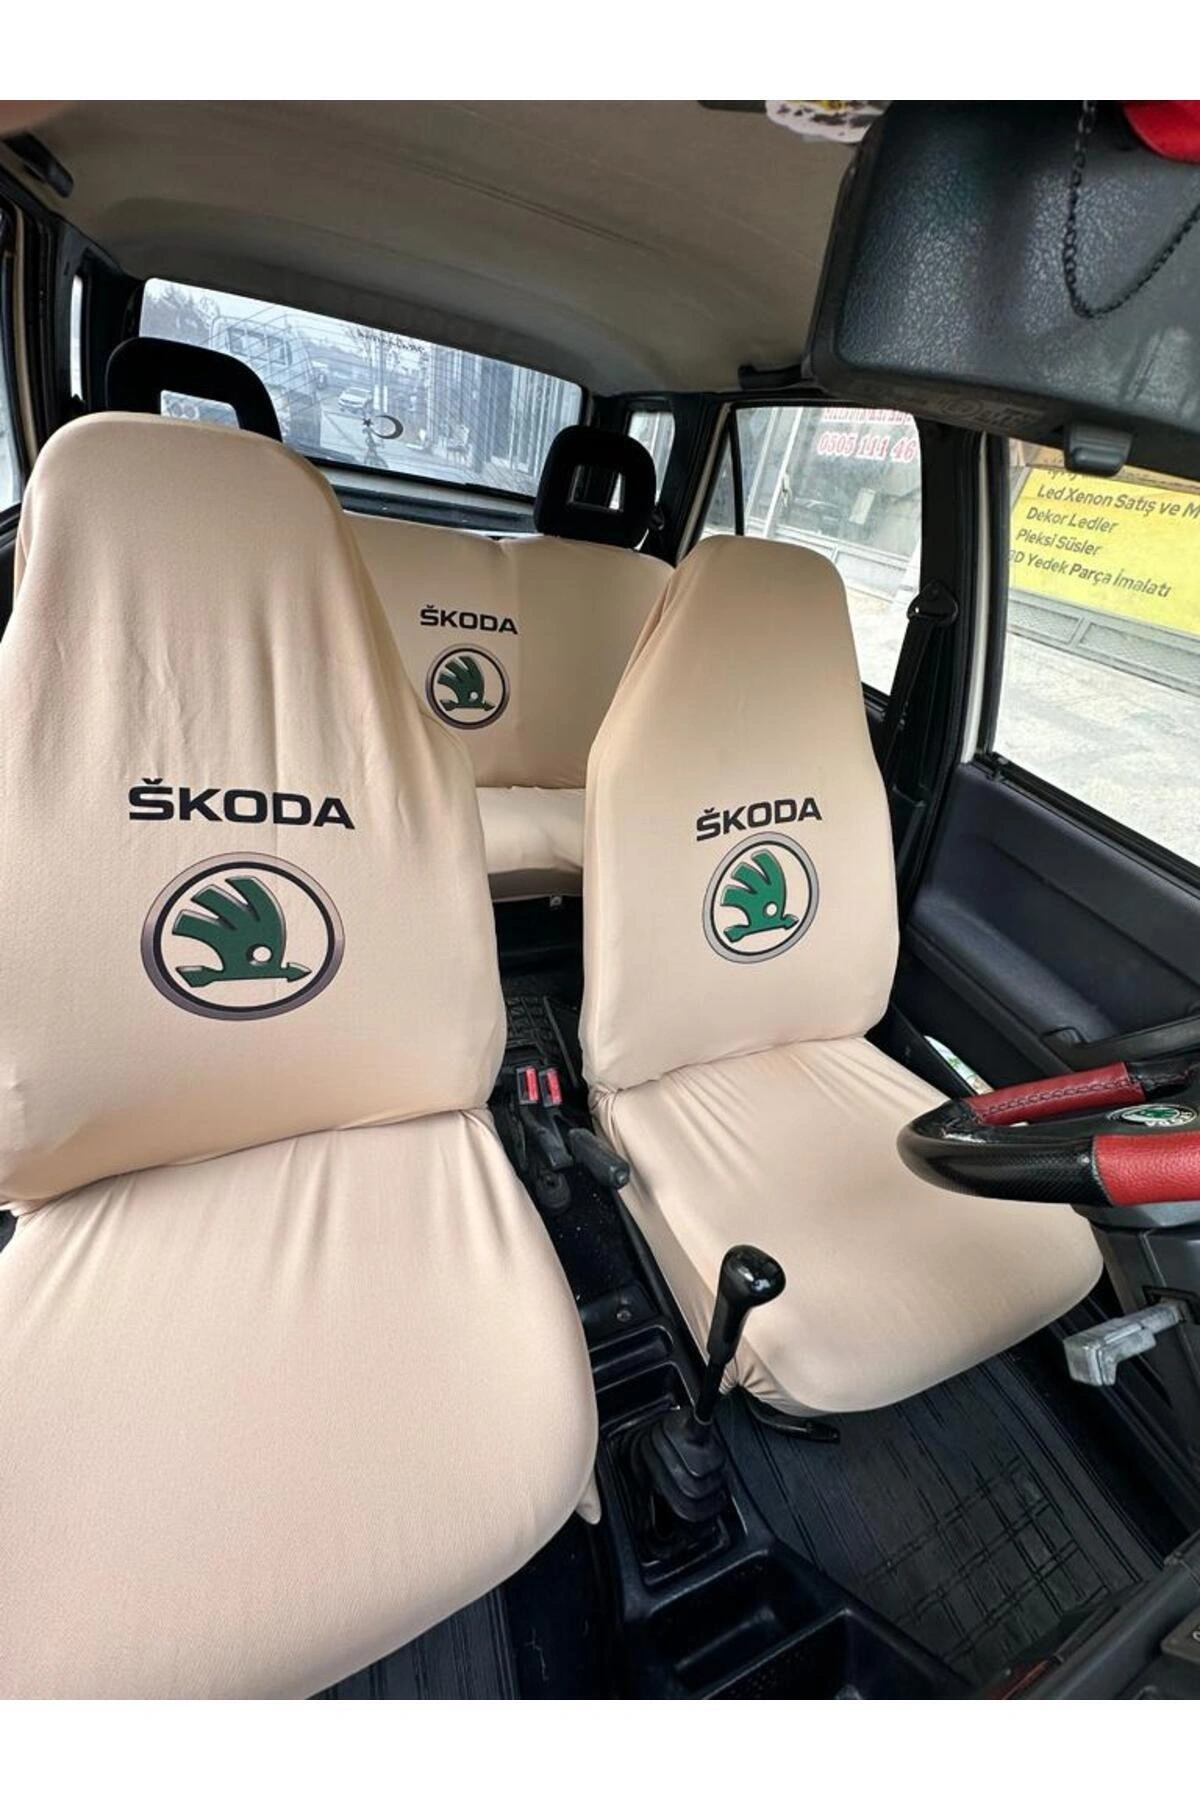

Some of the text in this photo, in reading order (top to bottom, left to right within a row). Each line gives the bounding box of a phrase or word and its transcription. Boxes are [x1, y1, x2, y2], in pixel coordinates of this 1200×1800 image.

[818, 432, 917, 462] 0505 111 46
[1037, 484, 1066, 500] Led
[1064, 488, 1113, 508] Xenon
[1113, 493, 1156, 518] Satış
[1159, 501, 1181, 516] ve
[1026, 506, 1120, 534] Dekor Ledler
[1015, 528, 1103, 557] Pleksi Süsler
[1027, 552, 1070, 575] Yedek
[1068, 562, 1113, 587] Parça
[1112, 568, 1172, 598] İmalatı
[419, 604, 519, 635] ŠKODA
[128, 778, 356, 830] ŠKODA
[696, 797, 823, 842] ŠKODA
